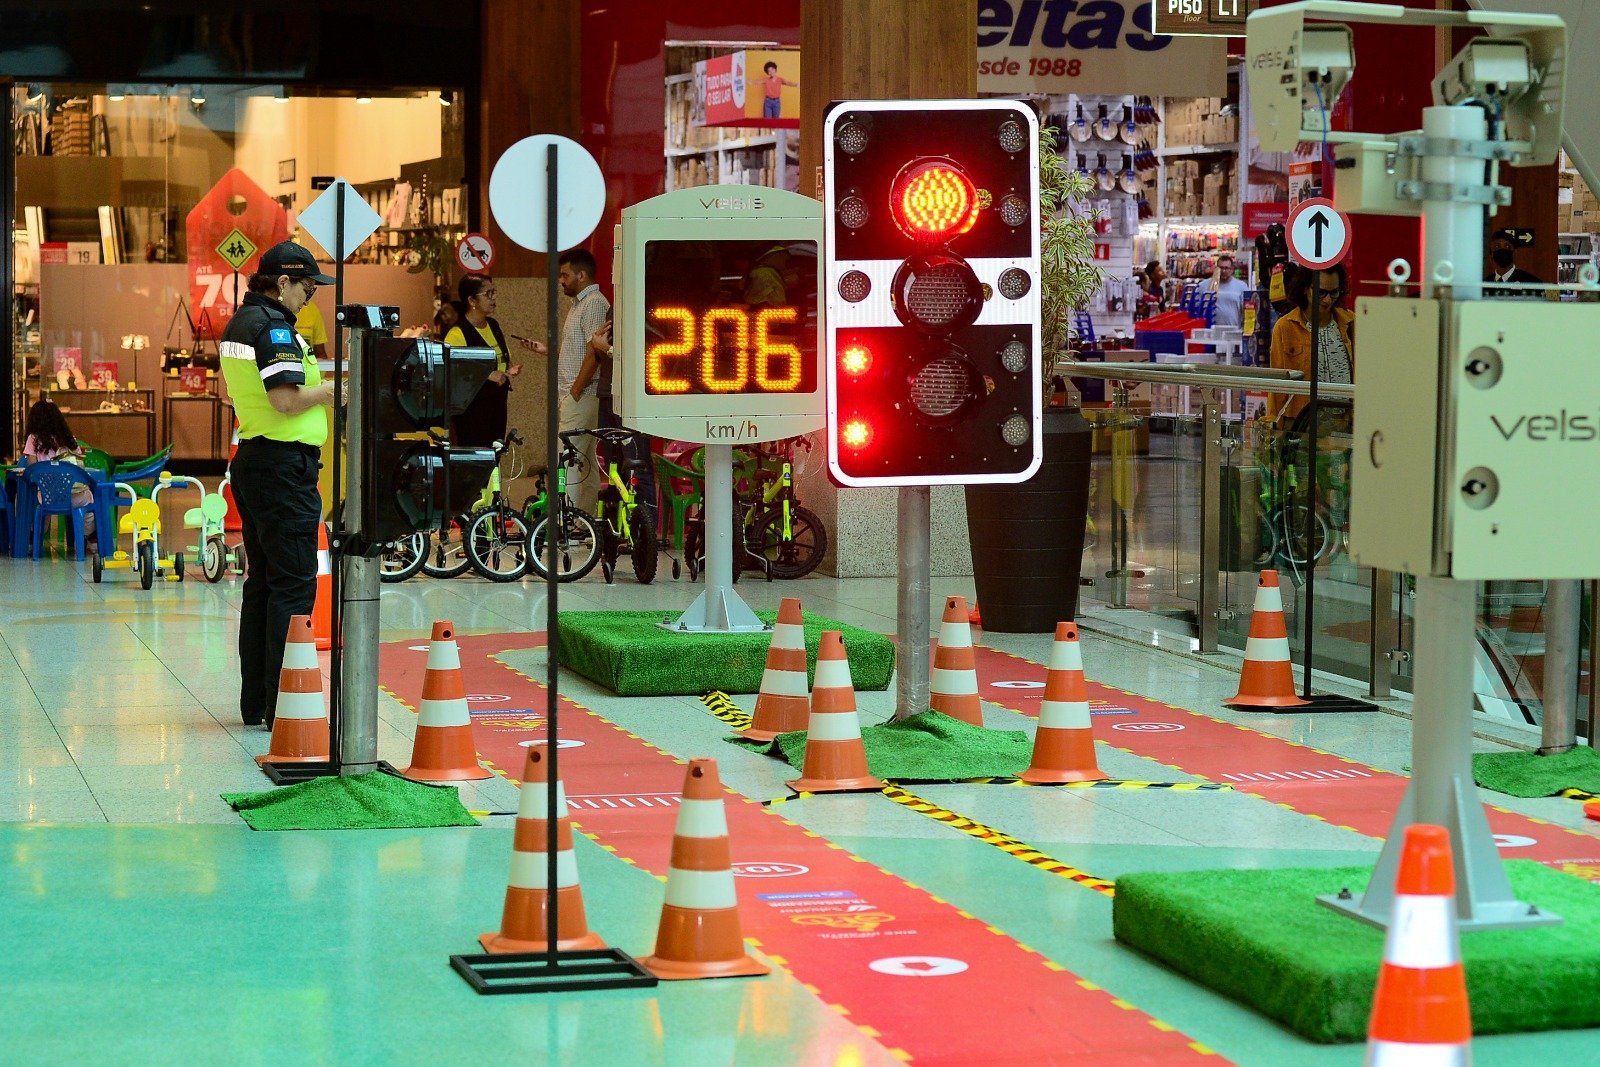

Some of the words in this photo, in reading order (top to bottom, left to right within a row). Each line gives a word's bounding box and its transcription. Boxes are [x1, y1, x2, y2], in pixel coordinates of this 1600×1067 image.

[1168, 0, 1202, 14] PISO
[977, 56, 1021, 75] sde
[1028, 57, 1082, 77] 1988
[196, 265, 213, 274] ATÉ
[195, 272, 249, 308] 70
[647, 306, 802, 393] 206
[705, 420, 759, 439] km/h
[1490, 408, 1600, 441] vels
